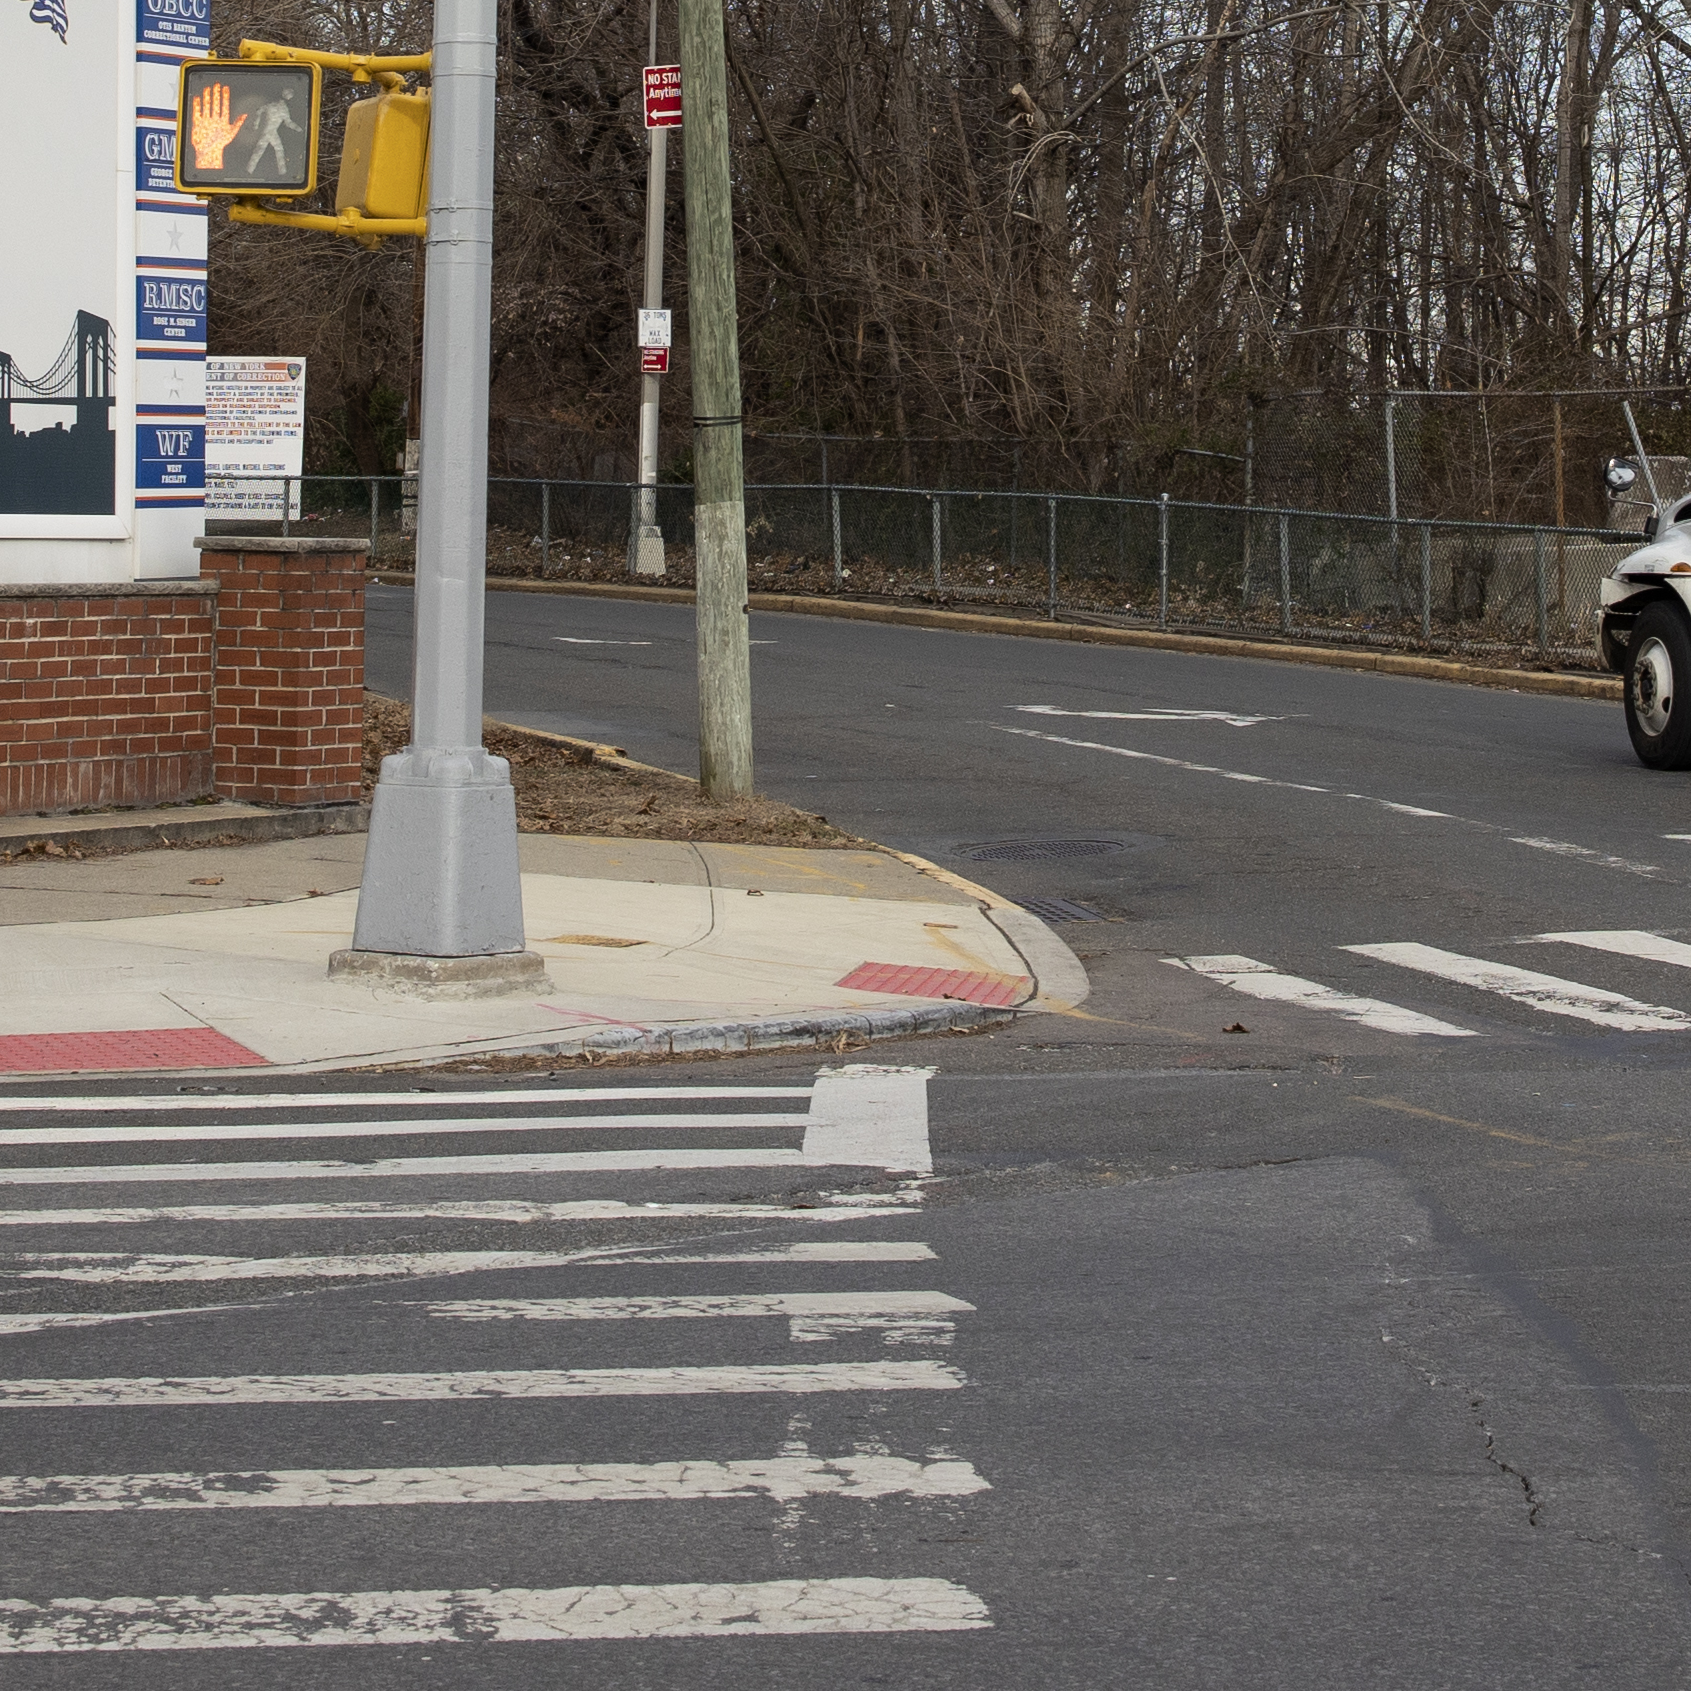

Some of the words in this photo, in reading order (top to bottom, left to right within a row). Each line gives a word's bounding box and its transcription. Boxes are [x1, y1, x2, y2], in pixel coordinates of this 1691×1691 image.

[648, 73, 661, 85] NO
[143, 281, 206, 311] RMSC
[211, 362, 221, 370] OF
[223, 362, 242, 370] NEW
[245, 362, 266, 370] YORK
[224, 372, 235, 381] OF
[237, 372, 286, 381] CORRECTION
[155, 429, 193, 456] WF
